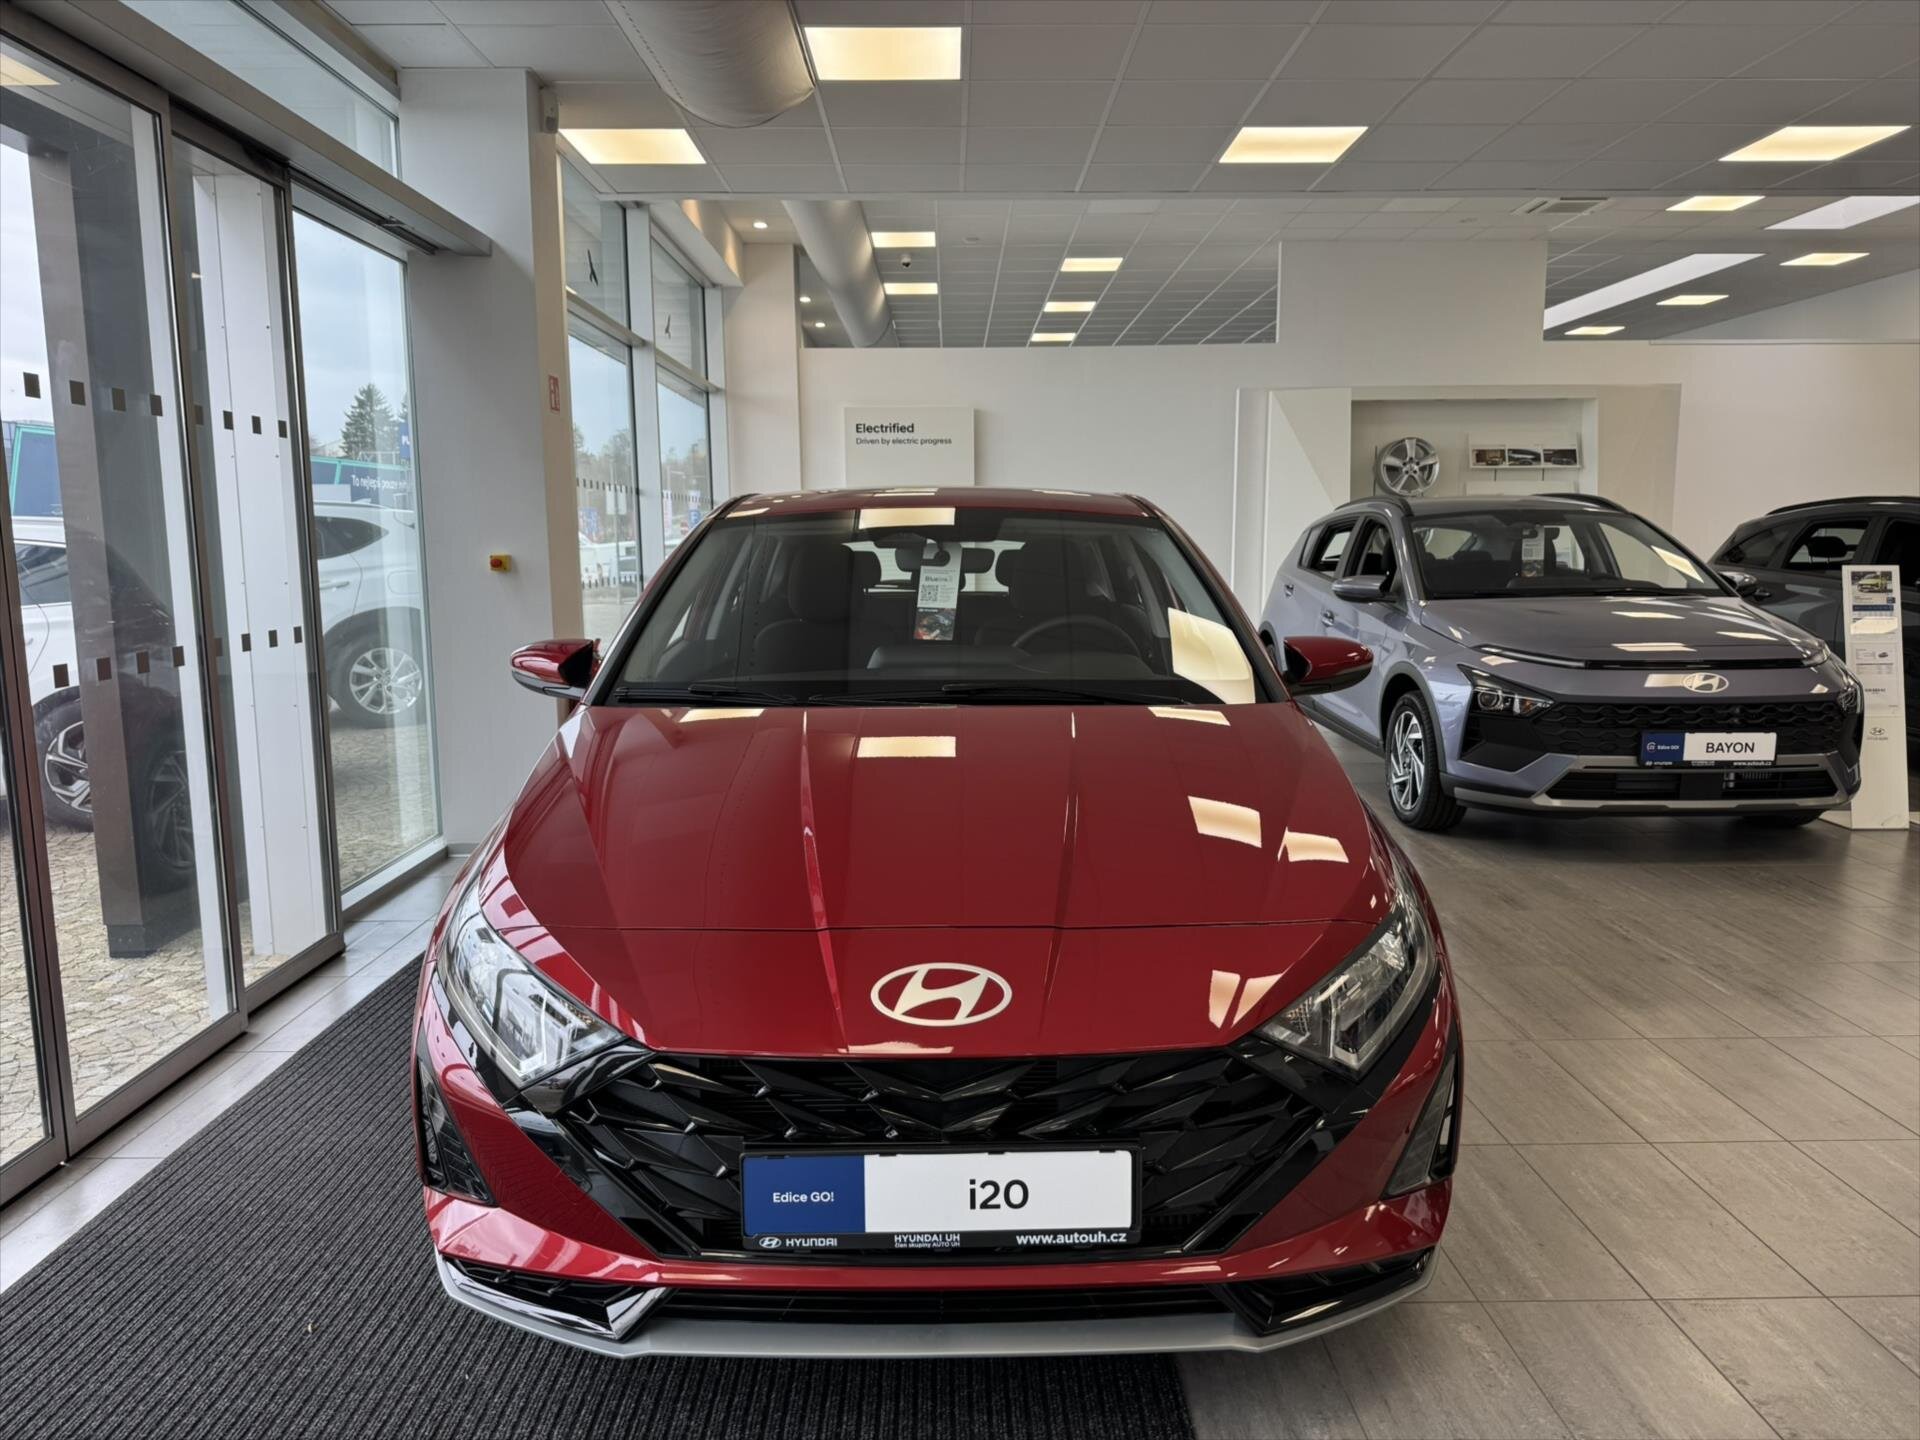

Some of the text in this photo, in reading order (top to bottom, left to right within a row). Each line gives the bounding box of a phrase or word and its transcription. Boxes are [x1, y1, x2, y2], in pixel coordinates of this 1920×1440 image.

[856, 422, 914, 433] Electrified
[856, 437, 952, 446] Driven by electric progress
[1705, 742, 1755, 753] BAYON
[773, 1191, 834, 1203] Edice GO!
[969, 1178, 1029, 1210] i20
[785, 1237, 838, 1247] HYUNDAI
[894, 1233, 960, 1242] HYUNDAI UH
[1015, 1231, 1127, 1246] www.autouh.cz
